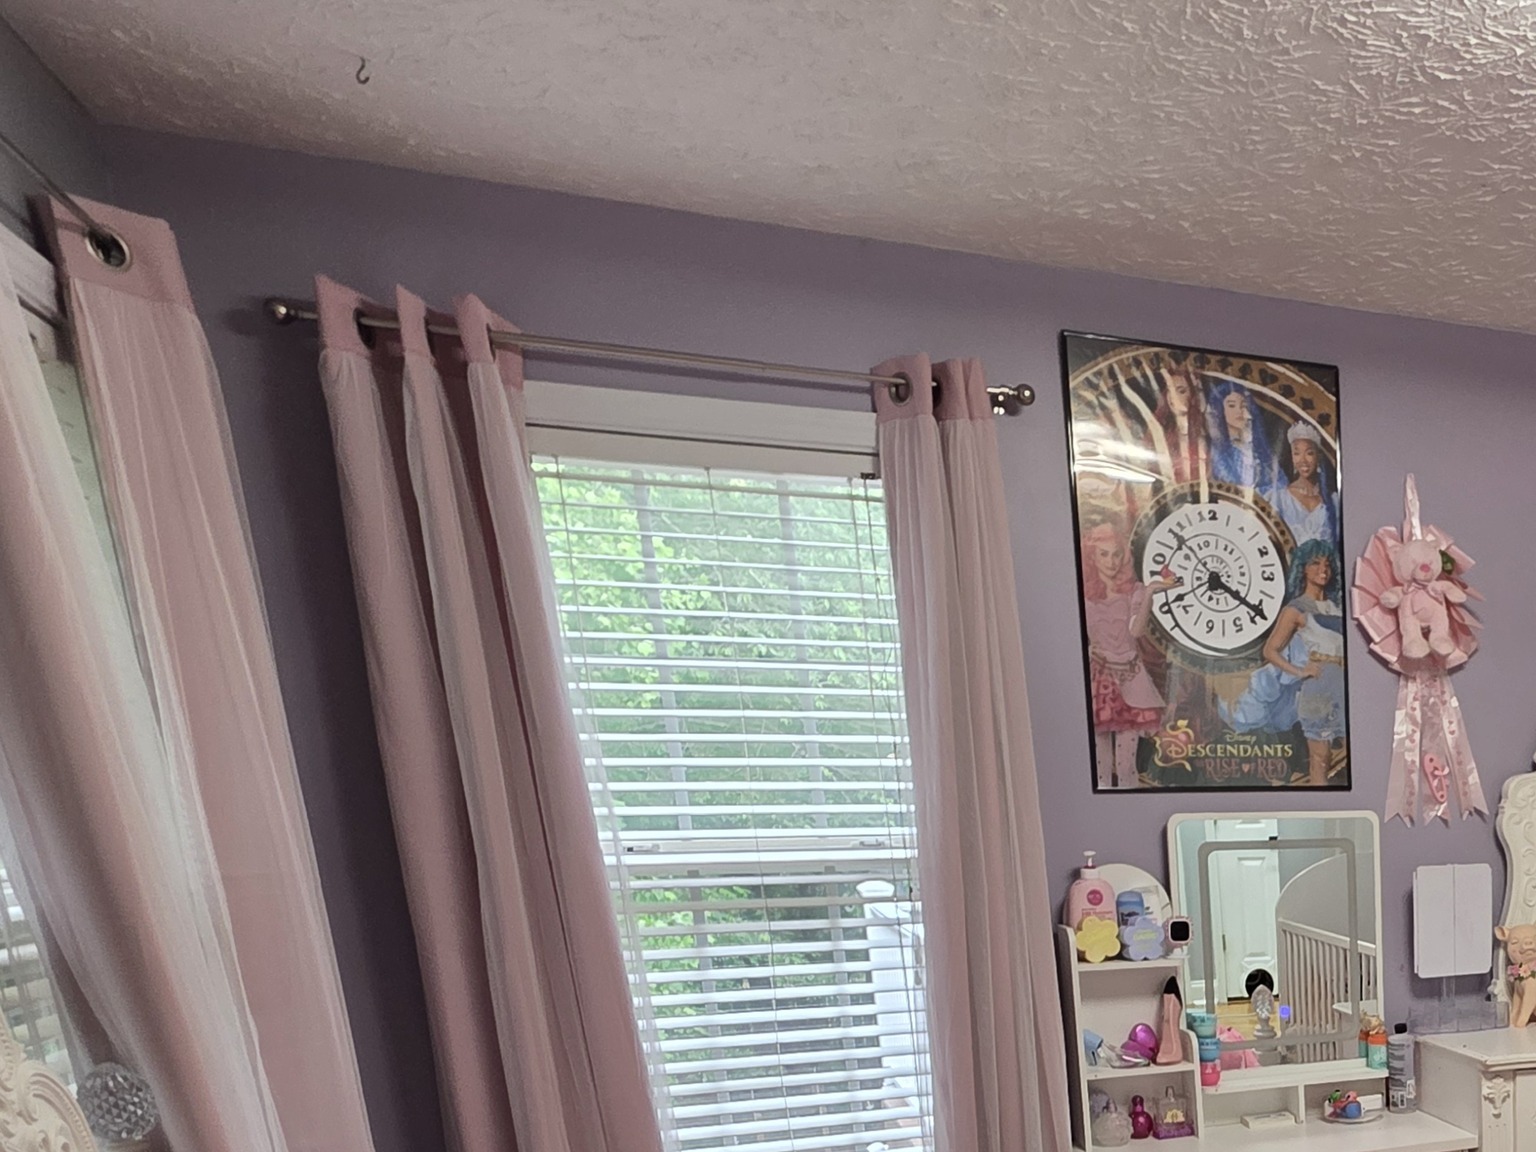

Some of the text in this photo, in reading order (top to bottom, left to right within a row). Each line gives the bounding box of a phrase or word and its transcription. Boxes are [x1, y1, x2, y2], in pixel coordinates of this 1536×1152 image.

[1197, 509, 1218, 523] 12
[1257, 546, 1269, 558] 2
[1261, 570, 1275, 582] 3
[1162, 737, 1293, 758] DESCENDANTS
[1205, 758, 1287, 782] RISE RED
